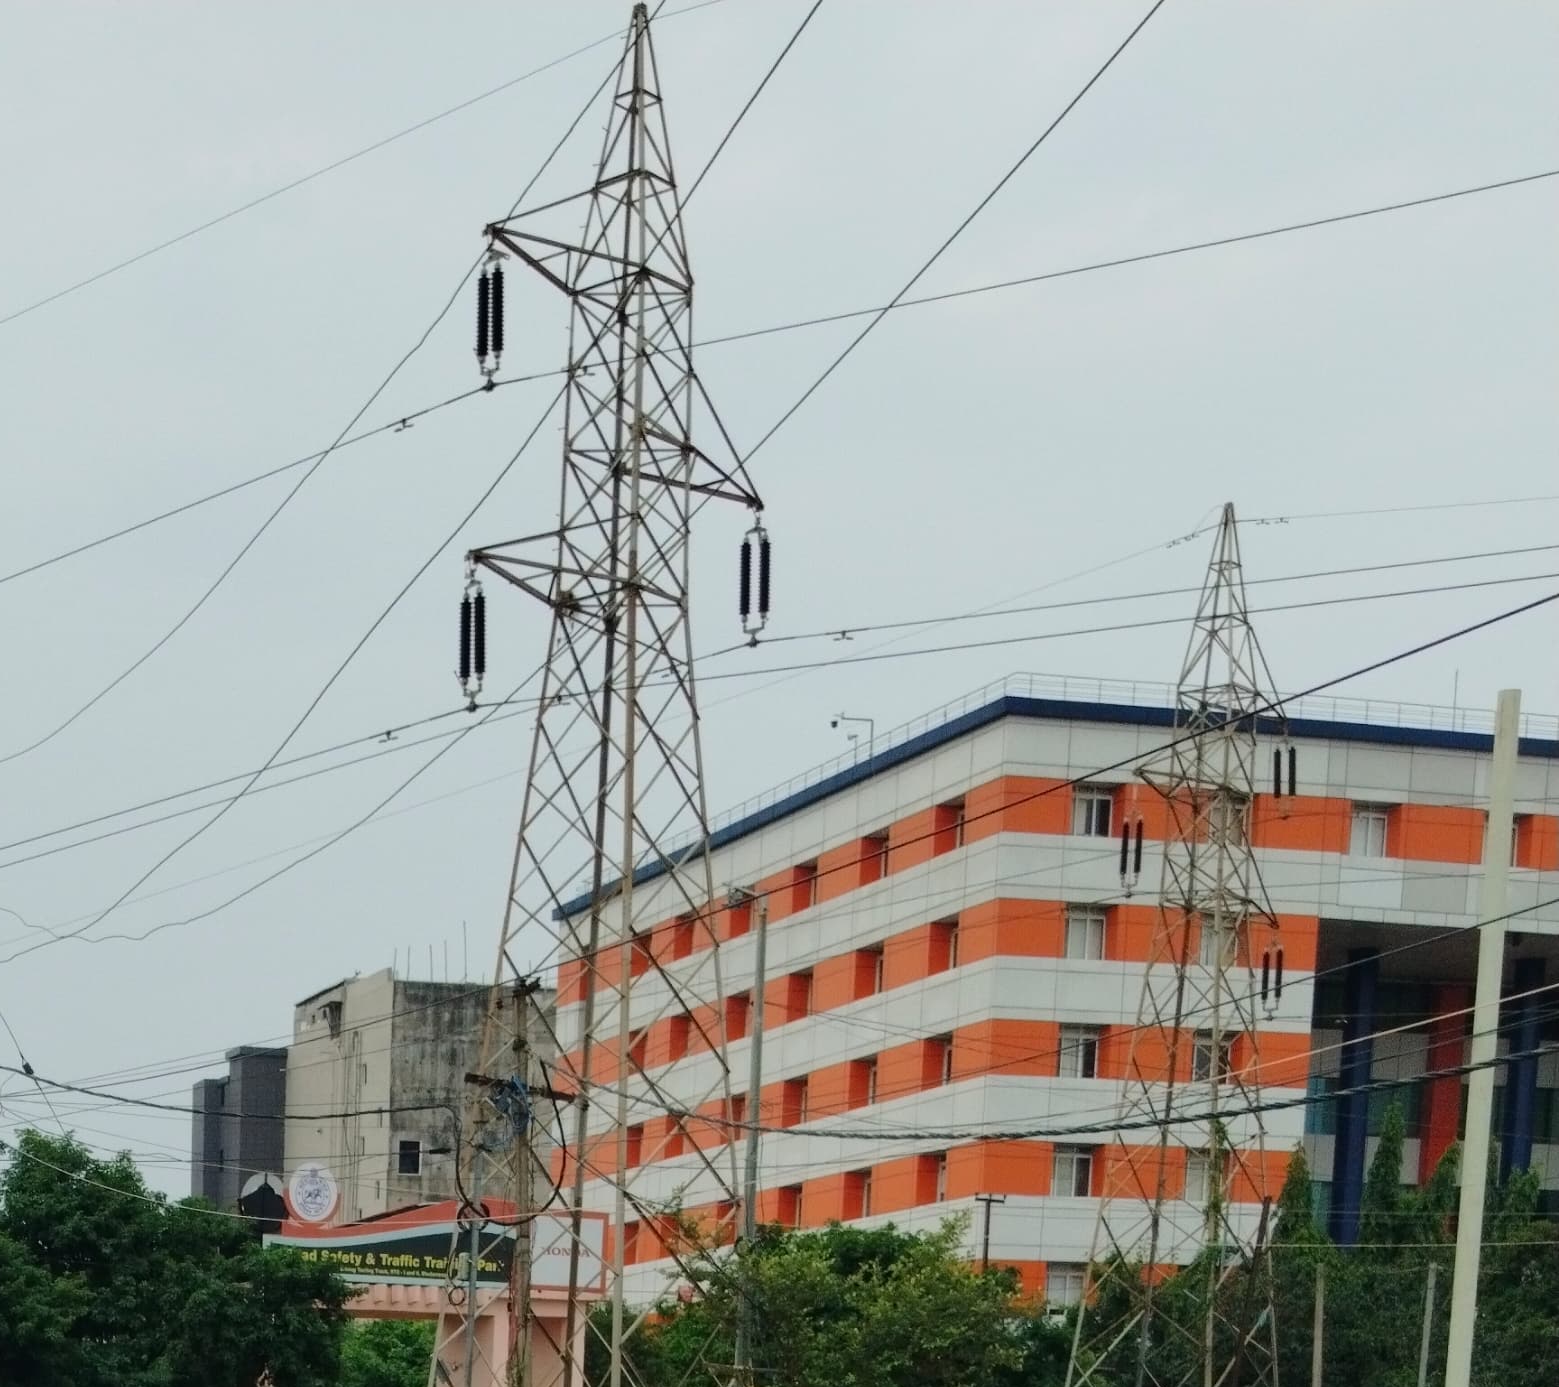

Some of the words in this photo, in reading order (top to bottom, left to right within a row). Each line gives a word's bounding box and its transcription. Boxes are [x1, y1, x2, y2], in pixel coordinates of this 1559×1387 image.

[321, 1249, 362, 1266] Safety
[365, 1252, 376, 1265] &
[379, 1253, 420, 1268] Traffic
[424, 1255, 473, 1271] Traii
